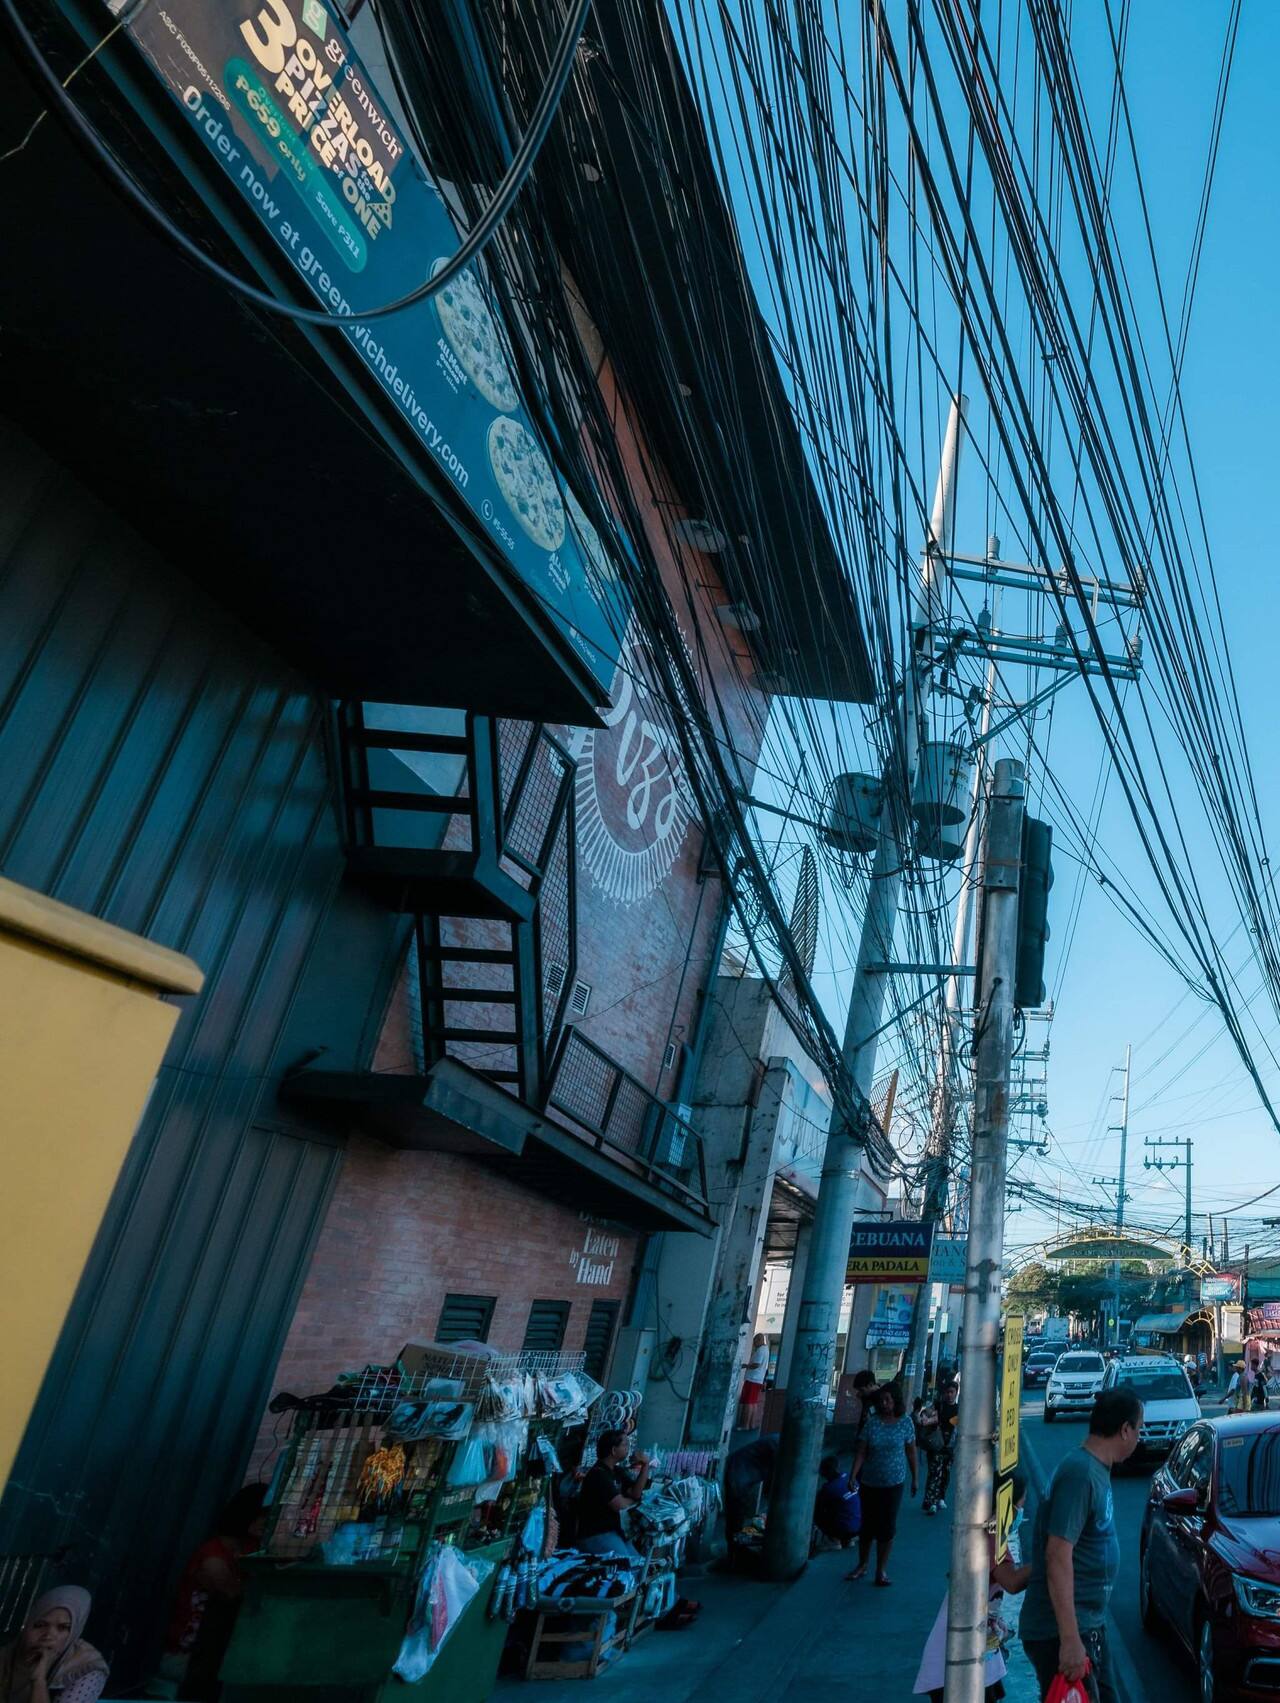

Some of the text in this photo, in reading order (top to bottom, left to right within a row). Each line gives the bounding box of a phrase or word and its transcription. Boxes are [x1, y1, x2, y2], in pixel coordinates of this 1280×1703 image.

[274, 70, 337, 168] PRICE
[342, 176, 381, 240] ONE
[284, 53, 361, 178] PIZZAS
[296, 38, 396, 204] OVERLOAD
[324, 38, 400, 159] greenwich
[183, 85, 241, 163] Order
[239, 165, 280, 219] now
[280, 221, 300, 250] at
[315, 191, 339, 227] Save
[576, 1256, 615, 1286] Hand
[872, 1260, 919, 1271] PADALA
[1006, 1407, 1015, 1429] PED
